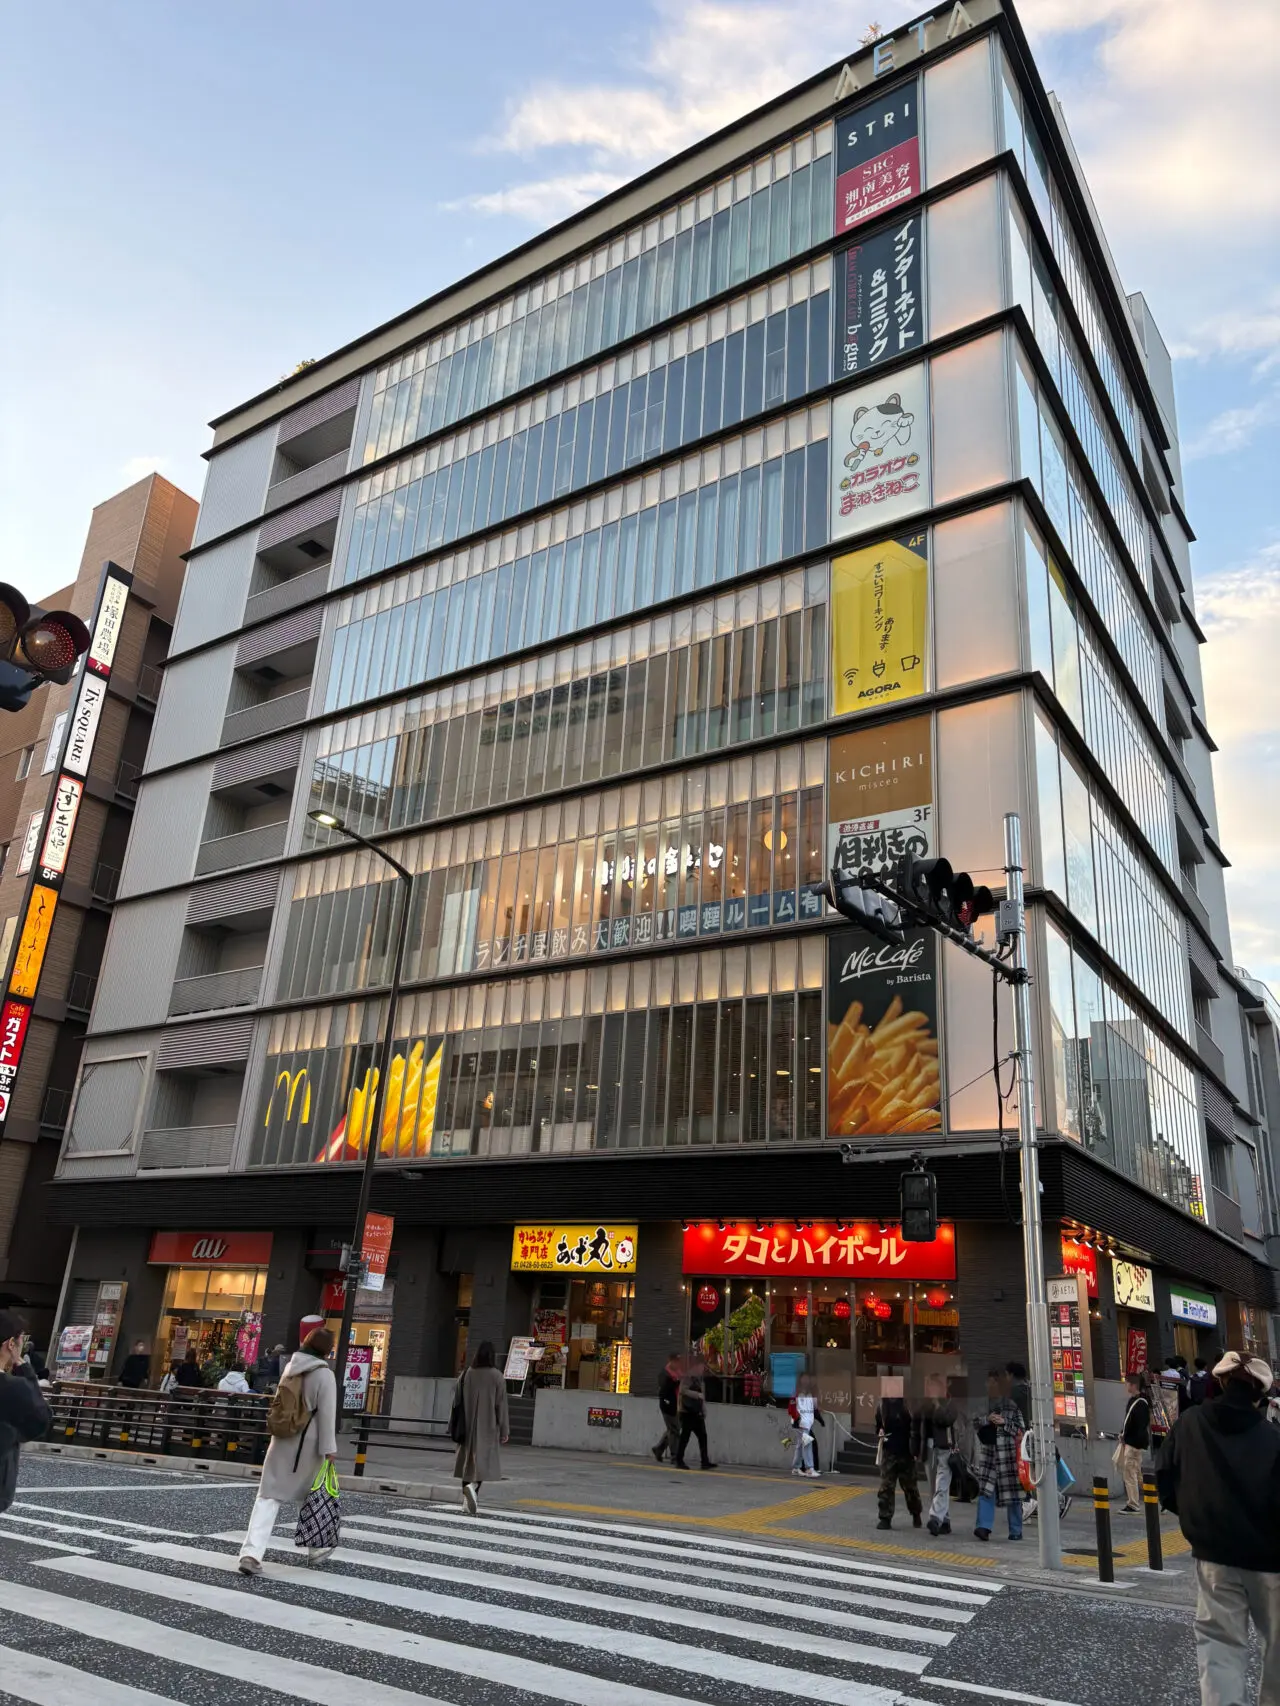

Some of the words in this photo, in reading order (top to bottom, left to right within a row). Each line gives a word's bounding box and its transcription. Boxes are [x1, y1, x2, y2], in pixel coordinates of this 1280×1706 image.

[847, 103, 909, 146] STRI
[862, 155, 894, 179] SBC
[846, 176, 910, 217] クリニック
[893, 219, 916, 350] インターネット
[850, 455, 908, 489] カラオケ
[839, 472, 921, 517] まねきねこ
[908, 534, 926, 547] 4F
[857, 681, 901, 699] AGORA
[70, 706, 92, 764] SQUARE
[835, 753, 924, 784] KICHIRI
[913, 806, 931, 822] 3F
[42, 868, 57, 881] 5F
[841, 938, 924, 979] McCafé
[15, 985, 29, 995] 4F
[896, 973, 932, 984] Barista
[0, 1016, 22, 1062] ガスト
[192, 1237, 229, 1260] au
[518, 1228, 555, 1245] からあげ
[556, 1227, 613, 1269] あげ丸
[520, 1244, 549, 1260] 専門店
